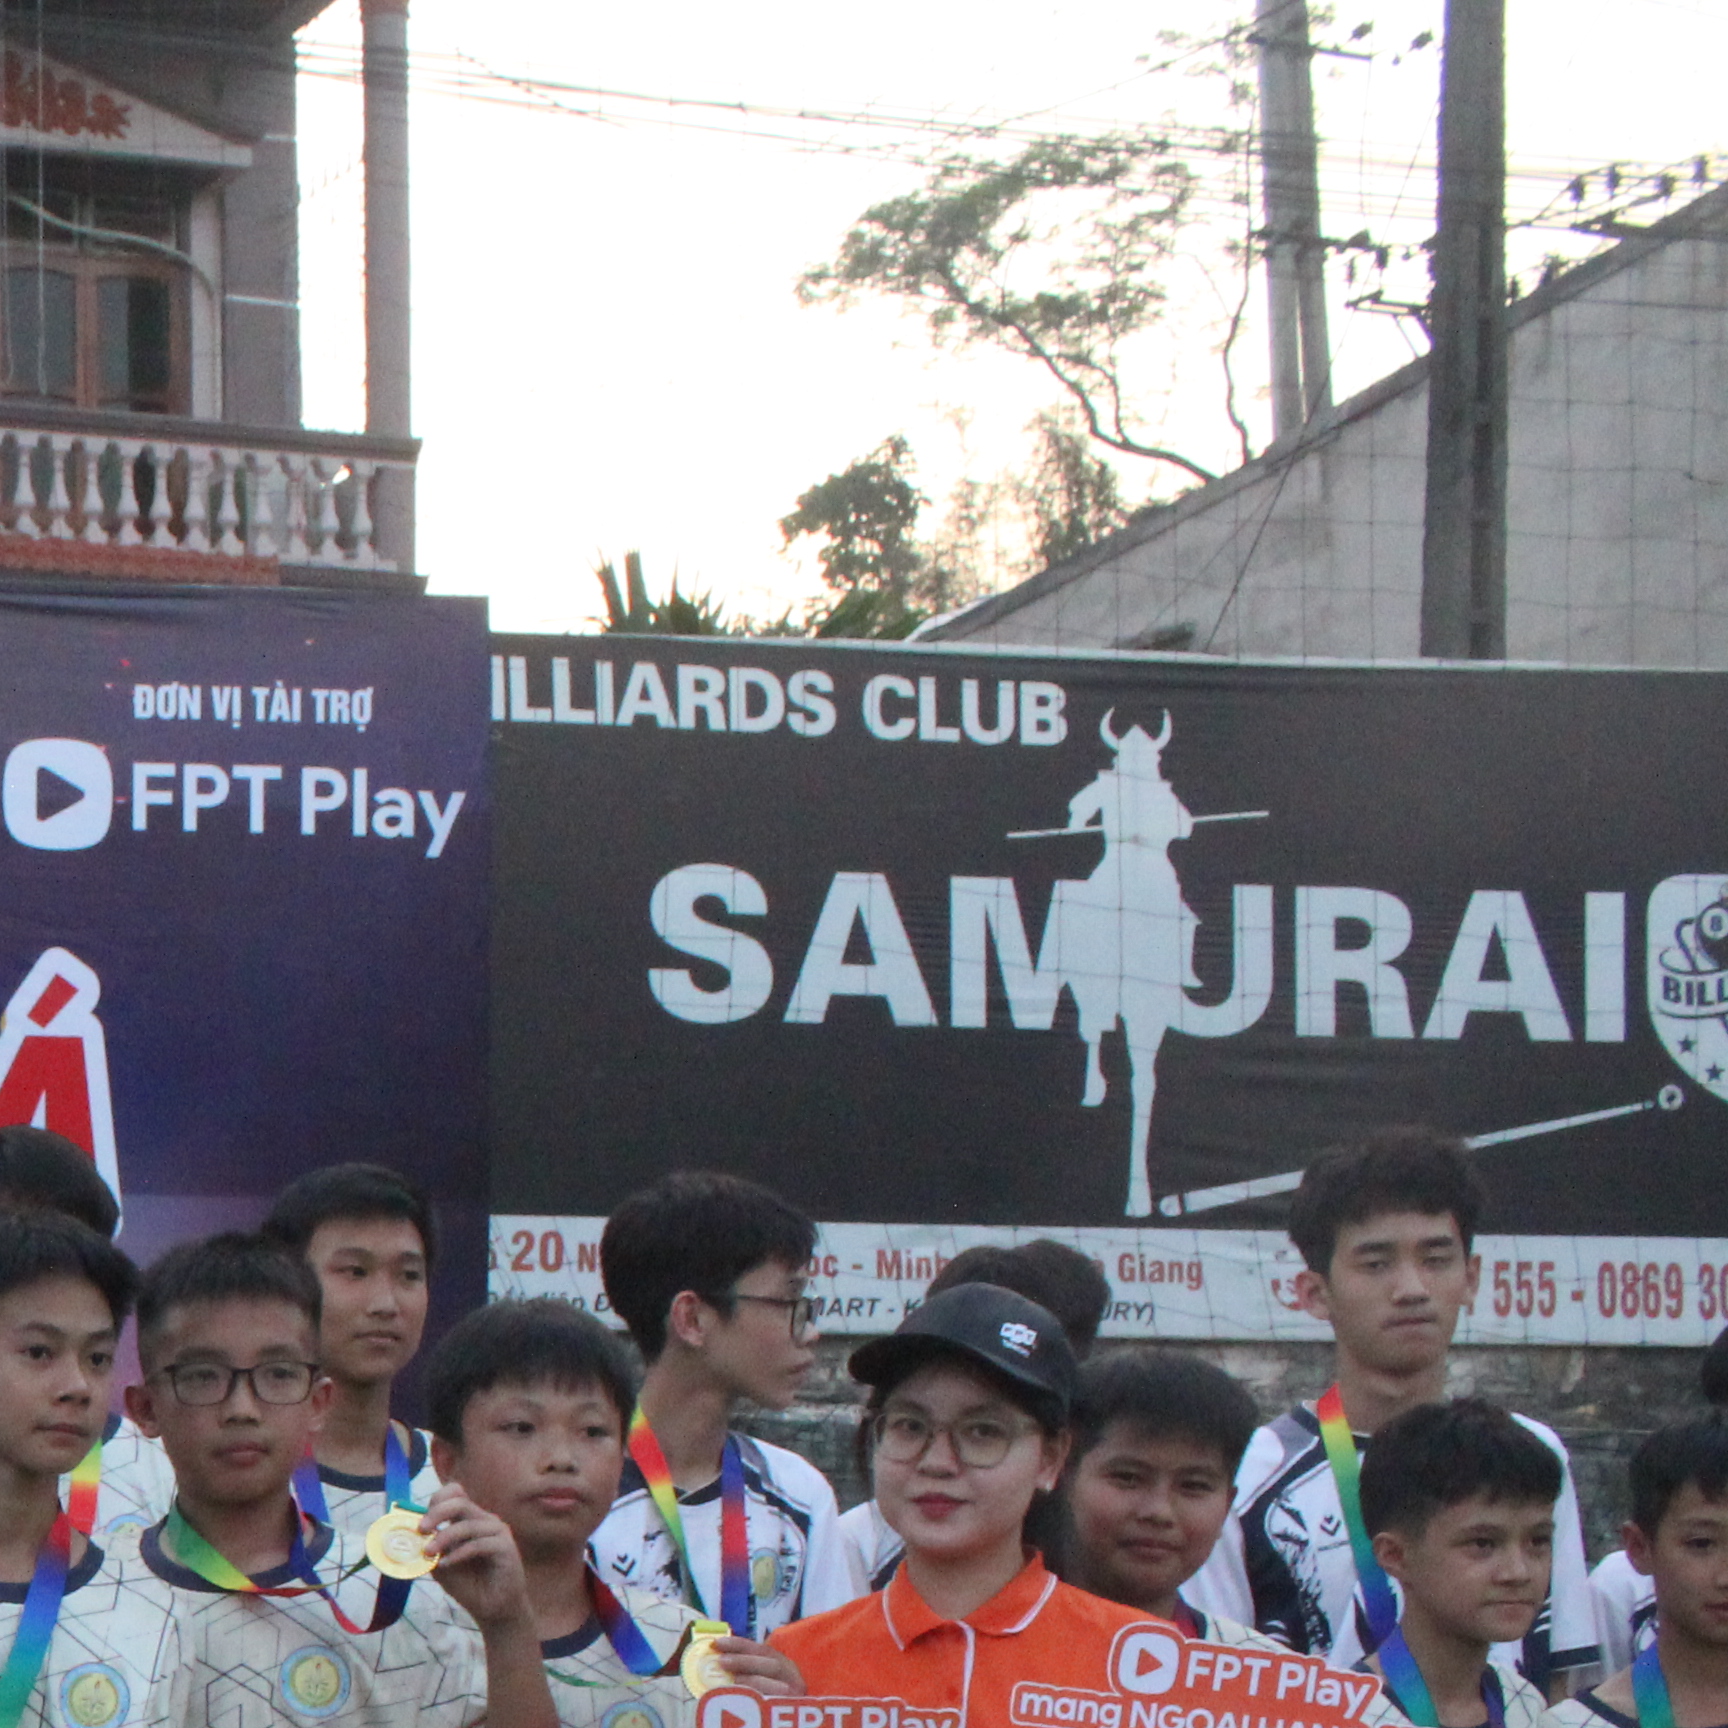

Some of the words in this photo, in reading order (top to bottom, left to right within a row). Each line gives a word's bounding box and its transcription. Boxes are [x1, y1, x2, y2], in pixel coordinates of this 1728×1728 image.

[133, 682, 200, 722] ĐƠN
[210, 685, 242, 729] VỊ
[251, 680, 302, 724] TÀI
[310, 685, 374, 733] TRỢ
[861, 673, 1068, 747] CLUB
[130, 762, 284, 835] FPT
[300, 766, 467, 858] Play
[647, 862, 1625, 1042] SAMURAI
[511, 1230, 564, 1273] 20
[1117, 1252, 1203, 1291] Giang
[1494, 1261, 1556, 1318] 555
[1598, 1261, 1684, 1319] 0869
[1184, 1650, 1272, 1696] FPT
[1277, 1662, 1371, 1720] Play
